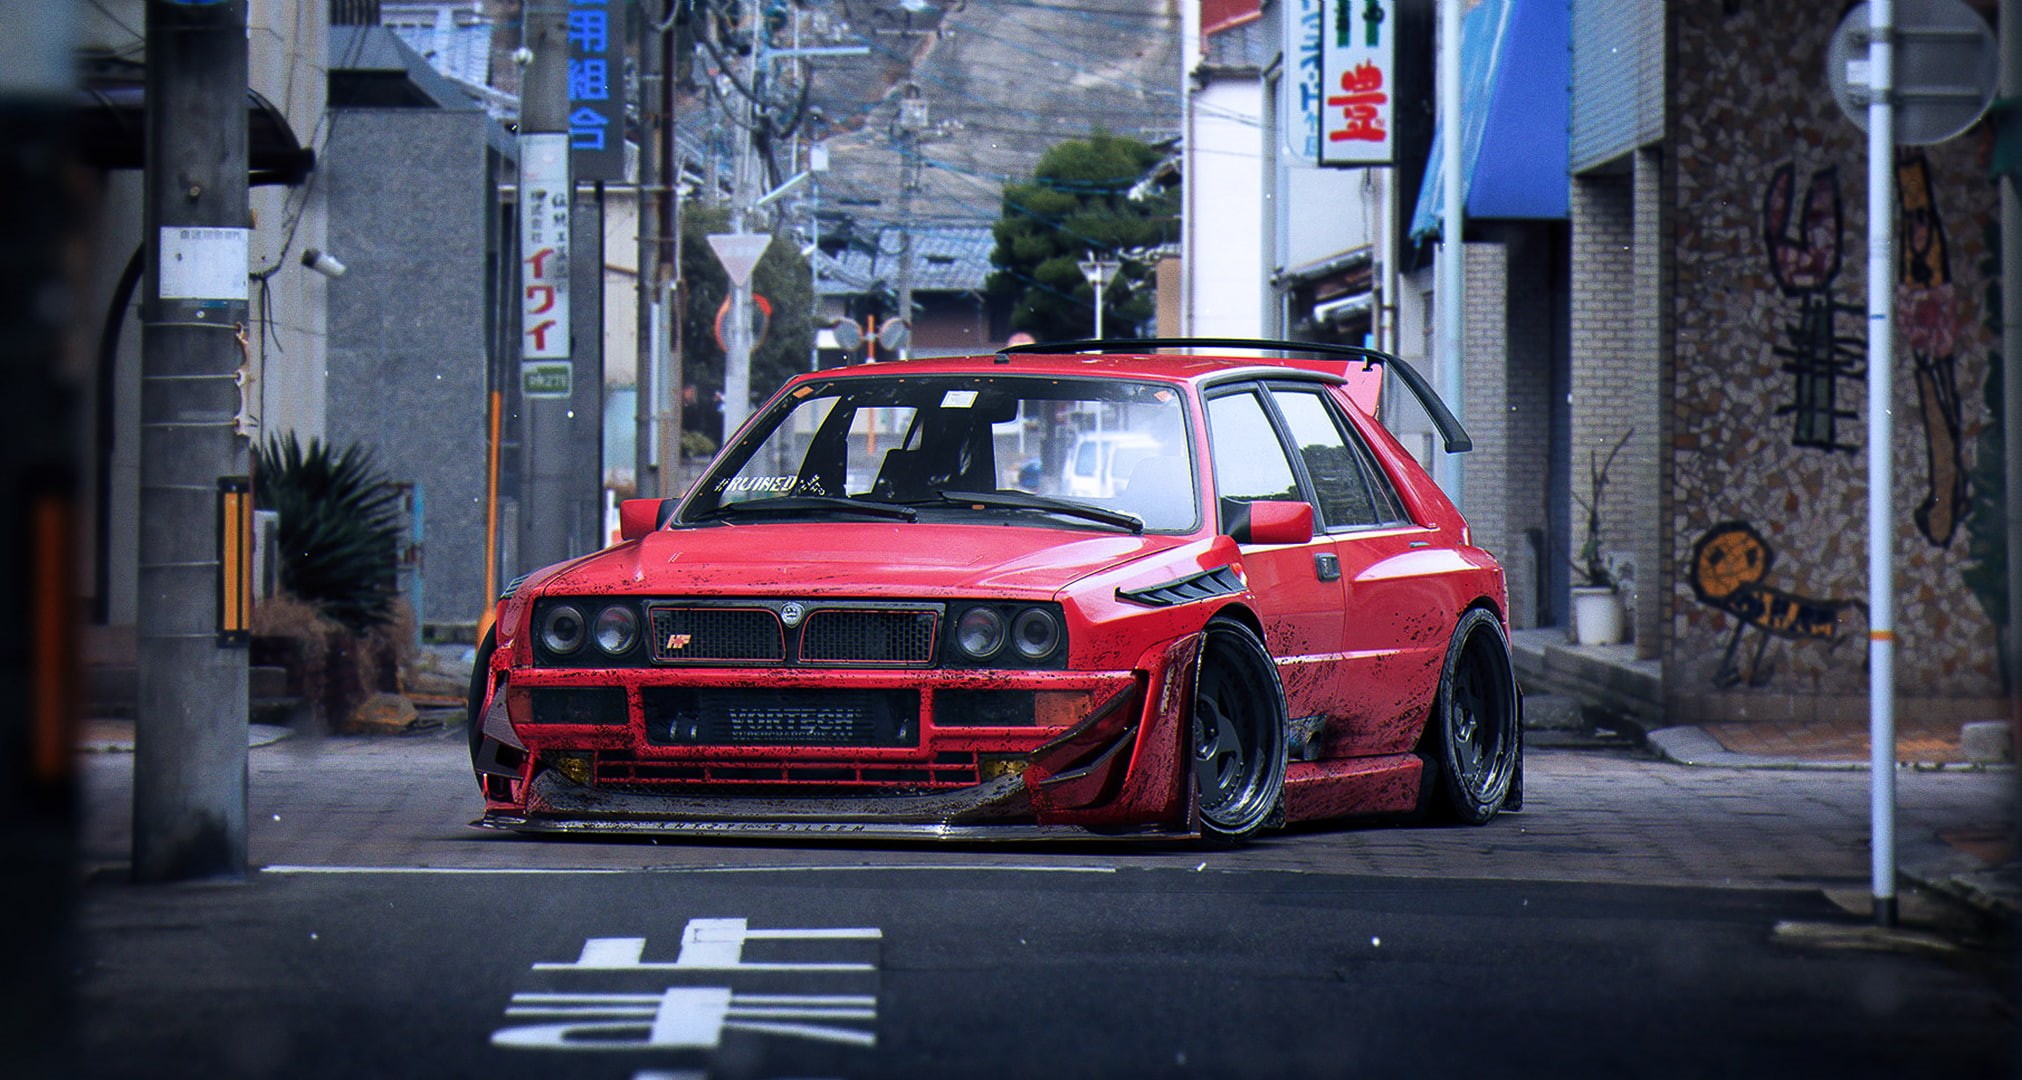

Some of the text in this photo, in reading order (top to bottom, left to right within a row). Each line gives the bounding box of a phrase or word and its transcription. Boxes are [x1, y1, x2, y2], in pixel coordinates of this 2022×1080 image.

[567, 0, 609, 149] 用組合
[1327, 58, 1388, 142] 豊
[523, 249, 556, 350] イワイ
[729, 708, 853, 730] VORTECH
[490, 917, 884, 1080] 止ま
